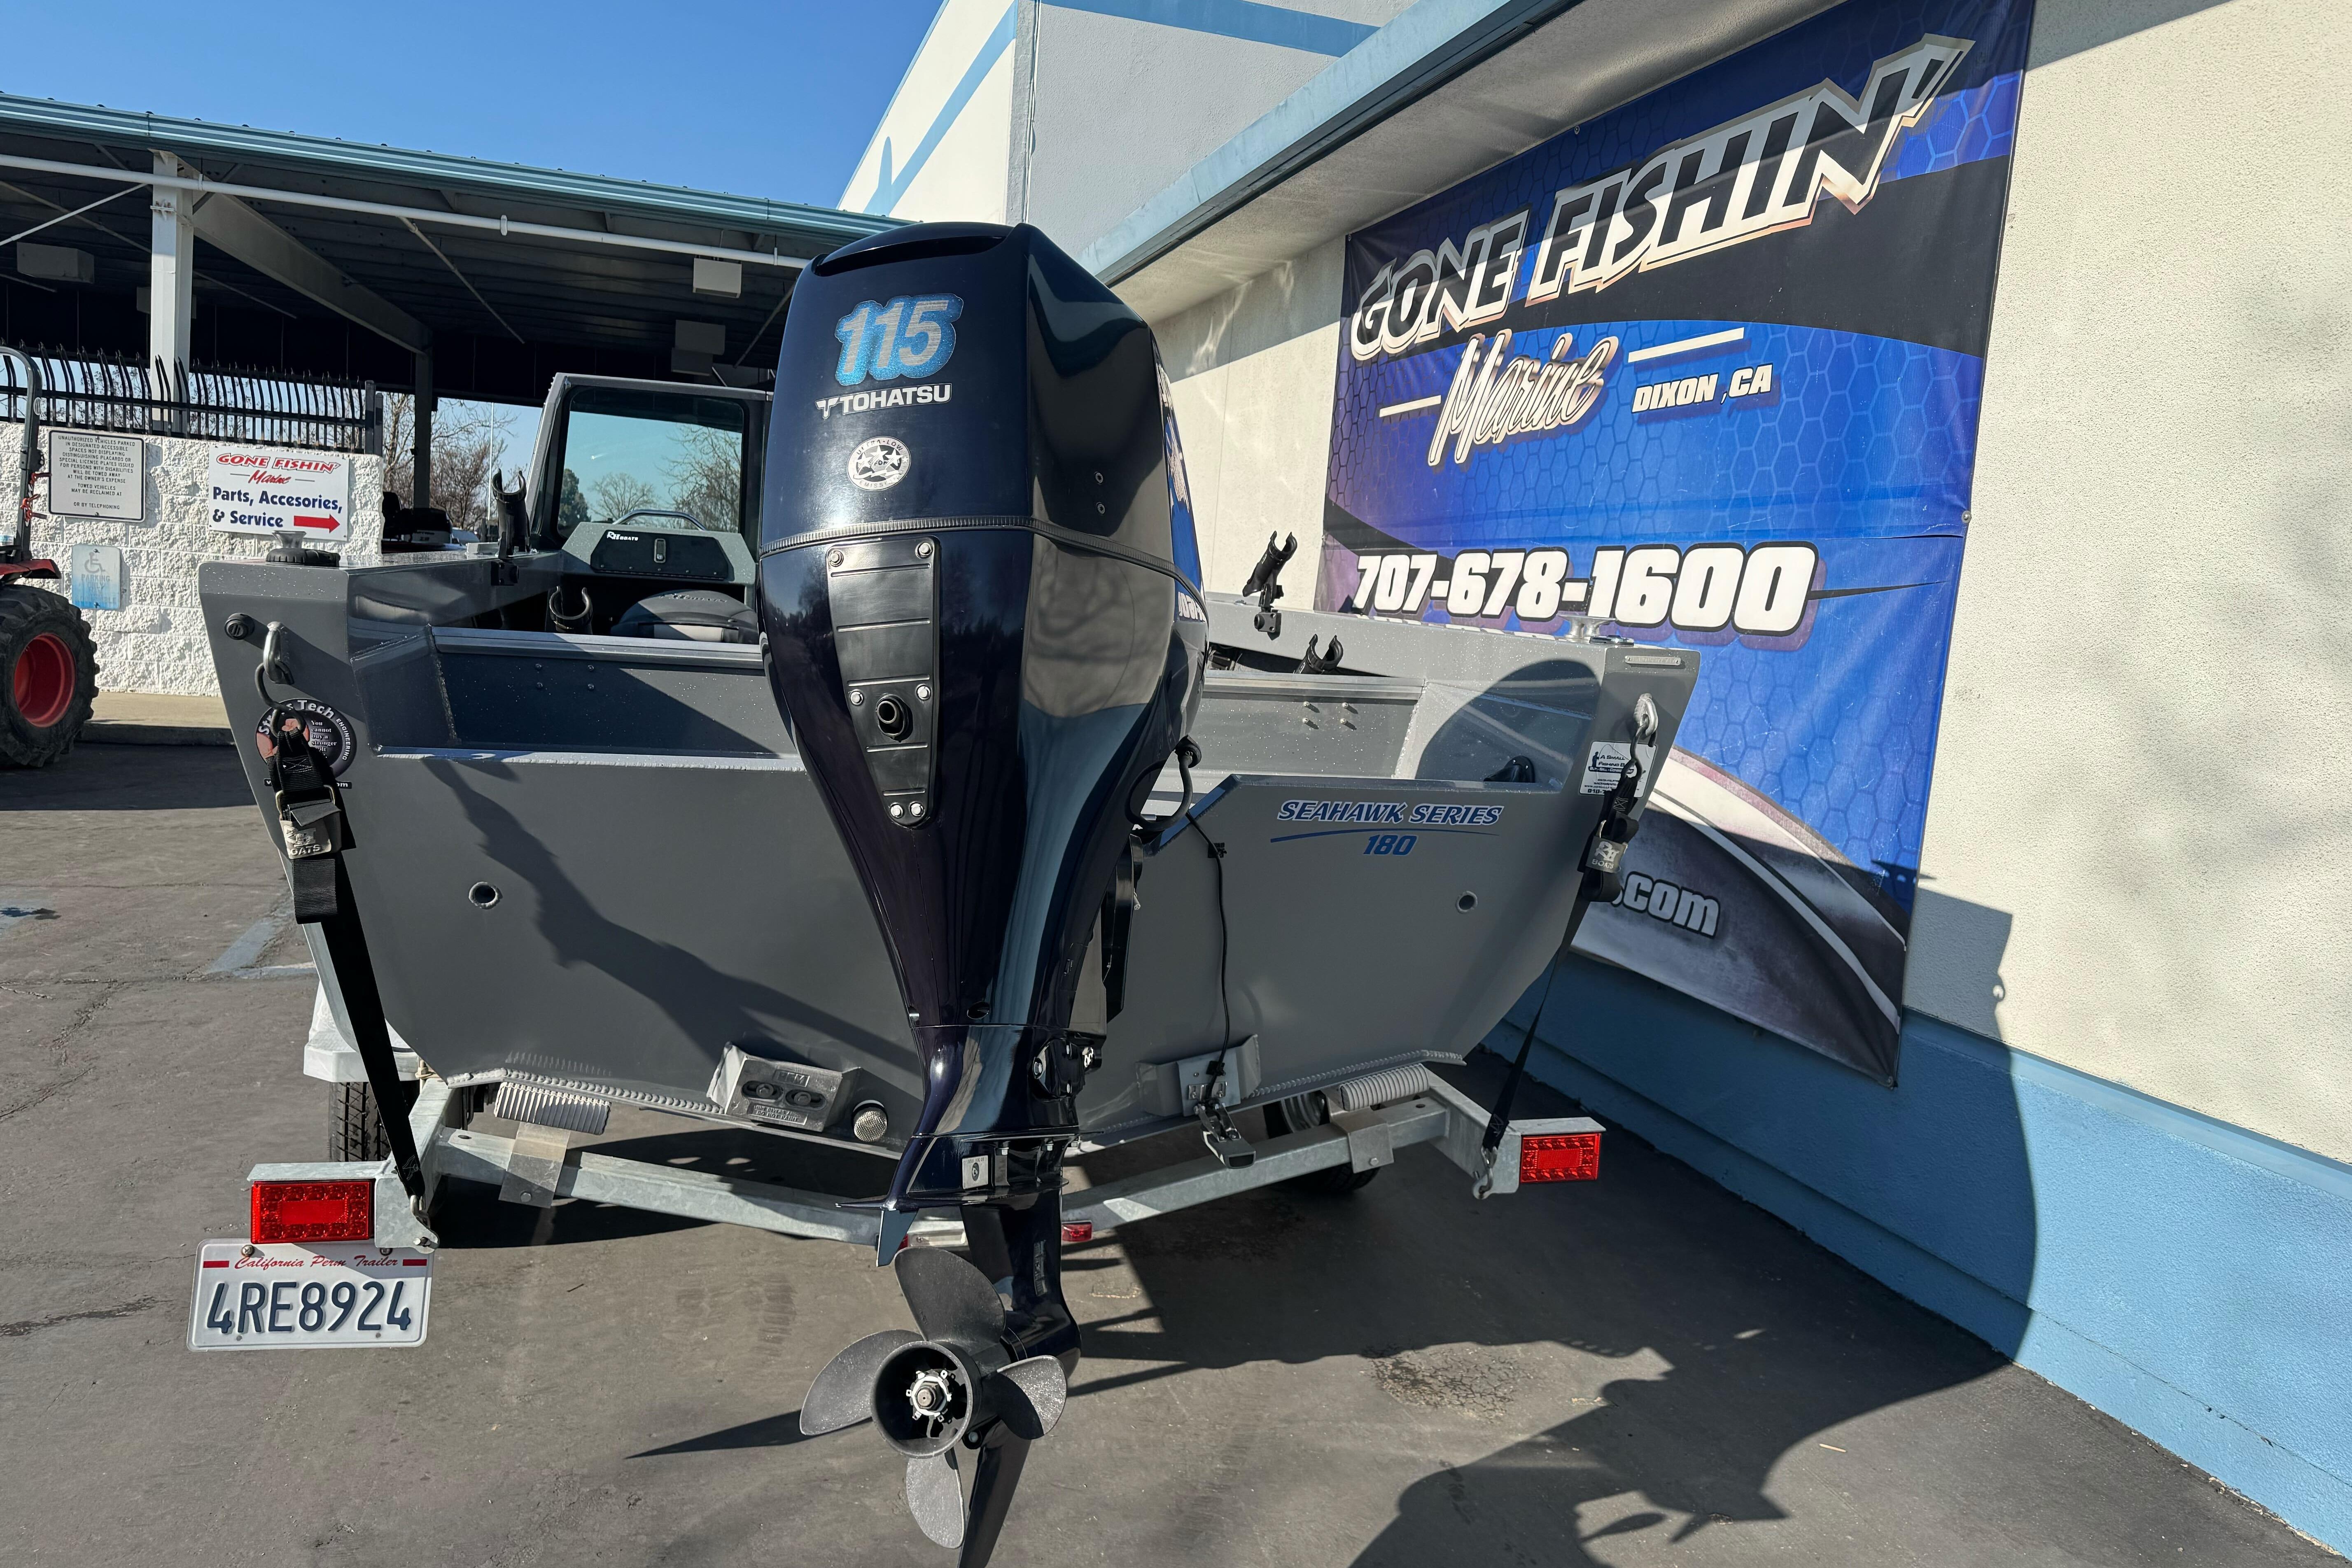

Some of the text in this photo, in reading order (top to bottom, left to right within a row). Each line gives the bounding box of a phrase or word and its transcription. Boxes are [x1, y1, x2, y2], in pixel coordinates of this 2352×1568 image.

[1351, 33, 1976, 360] GONE FISHIN'
[839, 296, 951, 376] 115
[839, 384, 951, 414] TOHATSU
[1428, 329, 1619, 467] Marine
[1631, 372, 1719, 413] DIXON
[216, 453, 341, 474] GONE FISHIN'
[213, 486, 342, 514] Parts, Accesories,
[212, 509, 284, 527] & Service
[81, 574, 110, 582] PARKING
[1351, 543, 1819, 637] 707-678-1600
[297, 700, 335, 719] Tech
[336, 718, 351, 761] ENGINEERING
[1277, 800, 1504, 826] SEAHAWK SERIES
[1363, 833, 1419, 856] 180
[235, 1255, 398, 1270] California Perm Trailer
[207, 1281, 411, 1334] 4RE8924
